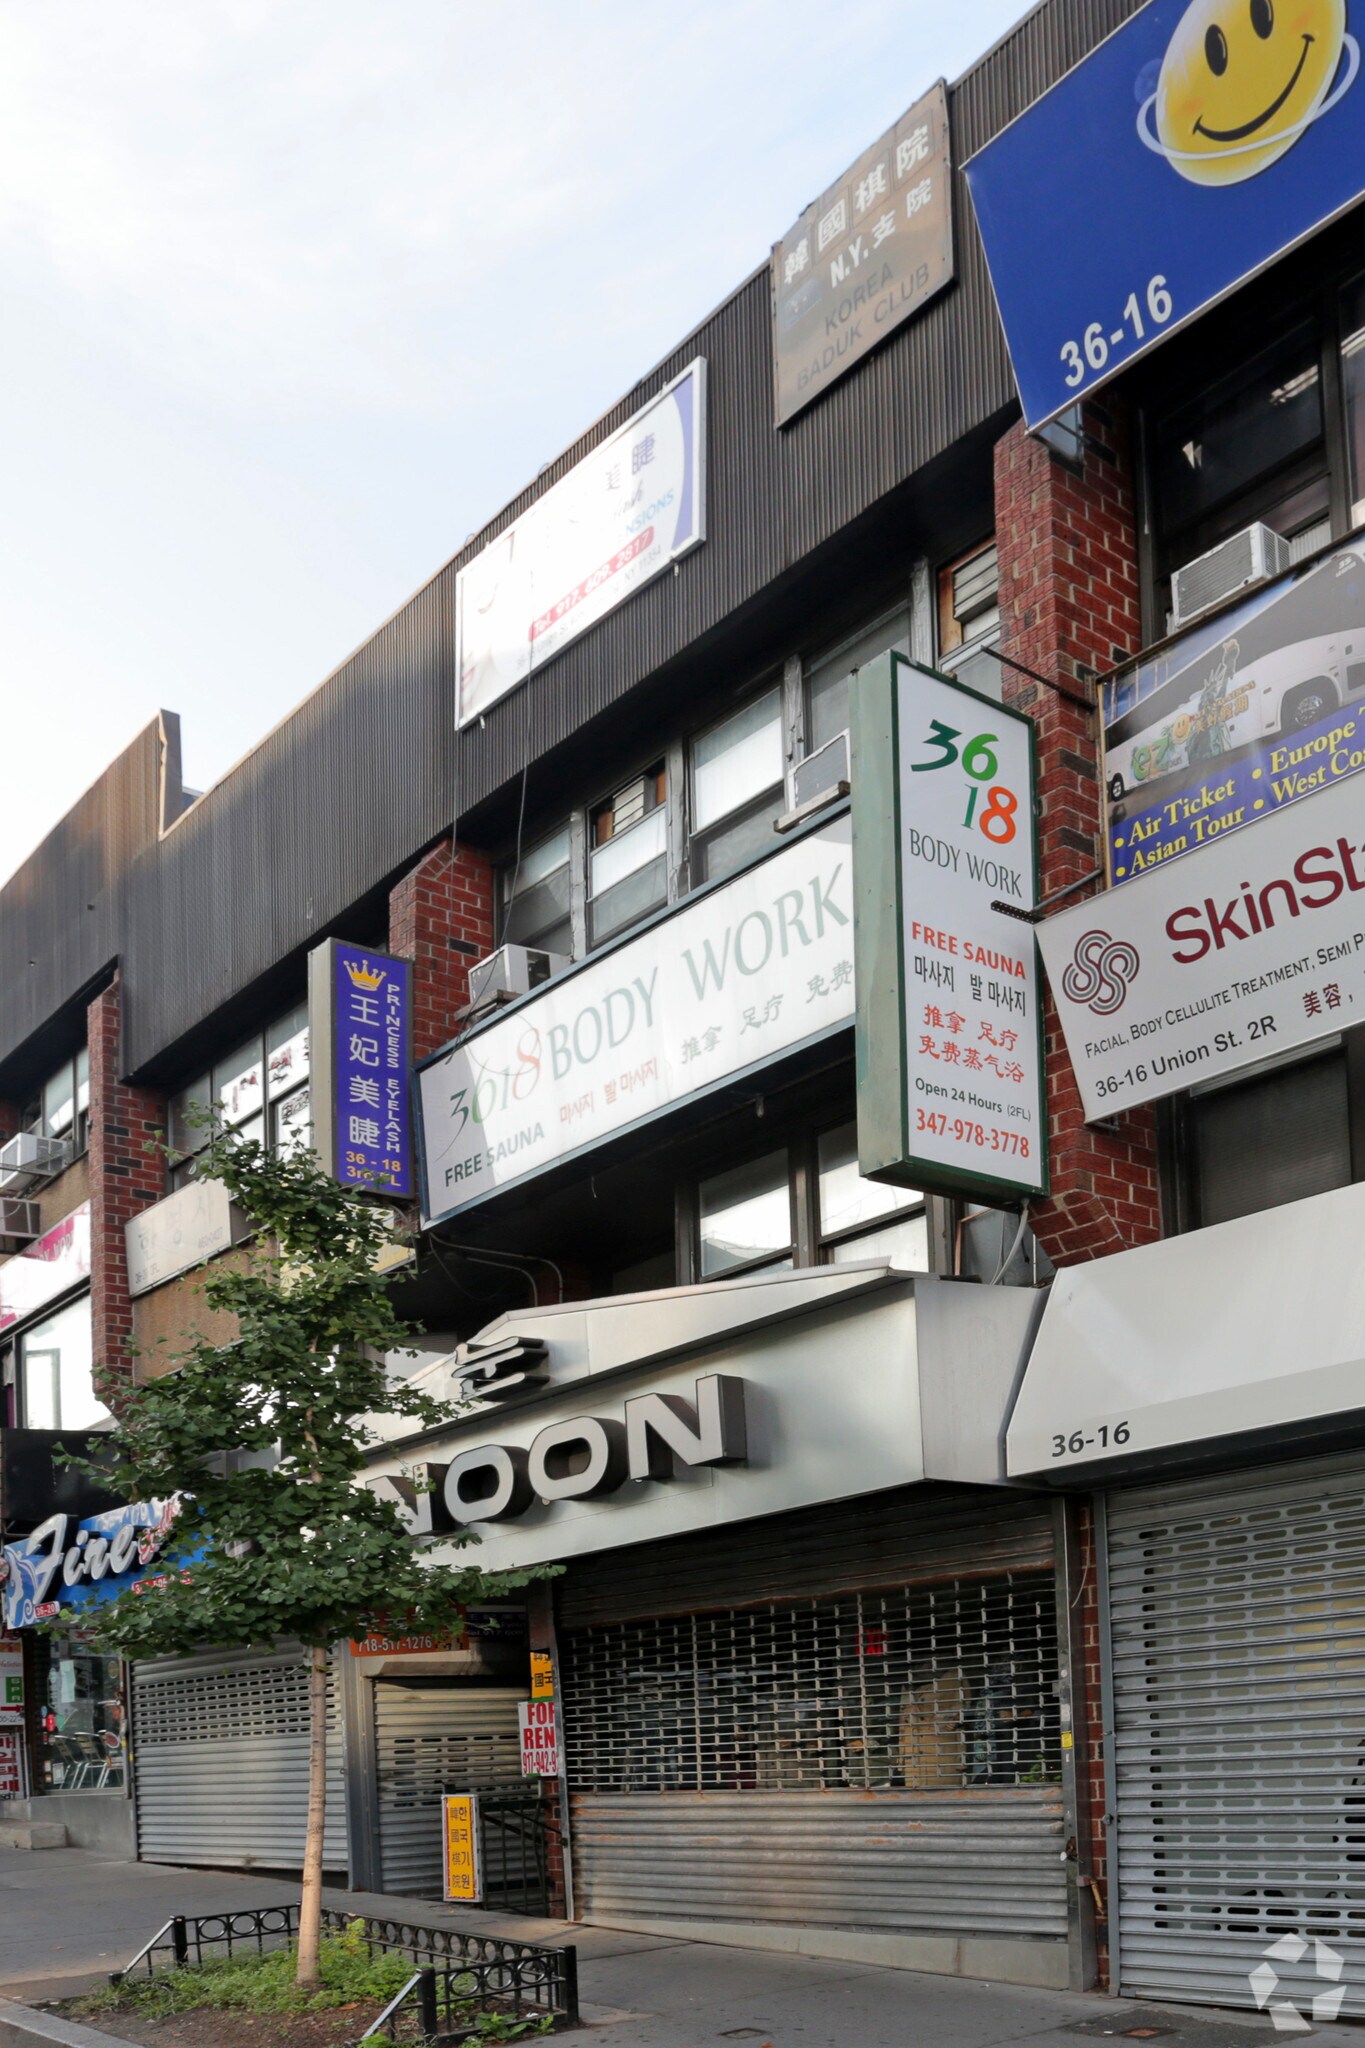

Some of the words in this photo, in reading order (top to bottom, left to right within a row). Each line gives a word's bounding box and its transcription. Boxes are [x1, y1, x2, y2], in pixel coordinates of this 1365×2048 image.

[829, 235, 868, 289] N.Y.
[797, 322, 863, 391] BADUK
[873, 263, 930, 324] CLUB
[824, 262, 893, 336] KOREA
[1059, 274, 1174, 387] 36-16
[911, 719, 999, 781] 36
[1269, 717, 1357, 776] Europe
[961, 784, 1018, 844] 18
[1127, 816, 1162, 848] Air
[1163, 778, 1237, 836] Ticket
[1271, 764, 1327, 804] West
[909, 828, 960, 873] BODY
[966, 852, 1022, 898] WORK
[1129, 831, 1188, 878] Asian
[1190, 803, 1246, 851] Tour
[912, 921, 958, 956] FREE
[964, 942, 1026, 980] SAUNA
[433, 1028, 540, 1163] 3618
[547, 966, 658, 1081] BODY
[681, 863, 850, 1002] WORK
[914, 956, 955, 992] 마사지
[970, 974, 983, 1002] 발
[988, 983, 1026, 1017] 마사지
[1130, 1017, 1163, 1041] BODY
[1165, 990, 1231, 1026] CELLULITE
[1317, 941, 1351, 966] SEMI
[386, 984, 400, 1068] PRINCESS
[923, 1004, 966, 1034] 推拿
[978, 1020, 1018, 1051] 足疗
[1095, 1064, 1147, 1098] 36-16
[1152, 1045, 1210, 1076] Union
[1214, 1030, 1242, 1053] St.
[1248, 1015, 1277, 1041] 2R
[349, 993, 380, 1149] 王妃美睫
[560, 1091, 594, 1124] 마사지
[604, 1079, 617, 1105] 발
[620, 1057, 658, 1093] 마사지
[681, 1025, 722, 1064] 推拿
[740, 993, 784, 1035] 足疗
[919, 1035, 1025, 1083] 免费蒸气浴
[385, 1079, 401, 1153] EYELASH
[915, 1077, 948, 1098] Open
[951, 1088, 966, 1103] 24
[968, 1094, 1003, 1113] Hours
[1007, 1103, 1031, 1122] (2FL)
[445, 1153, 482, 1187] FREE
[486, 1122, 545, 1167] SAUNA
[916, 1108, 1030, 1158] 347-978-3778
[1051, 1421, 1131, 1458] 36-16
[522, 1751, 558, 1774] 917-942-9
[523, 1727, 556, 1750] REN
